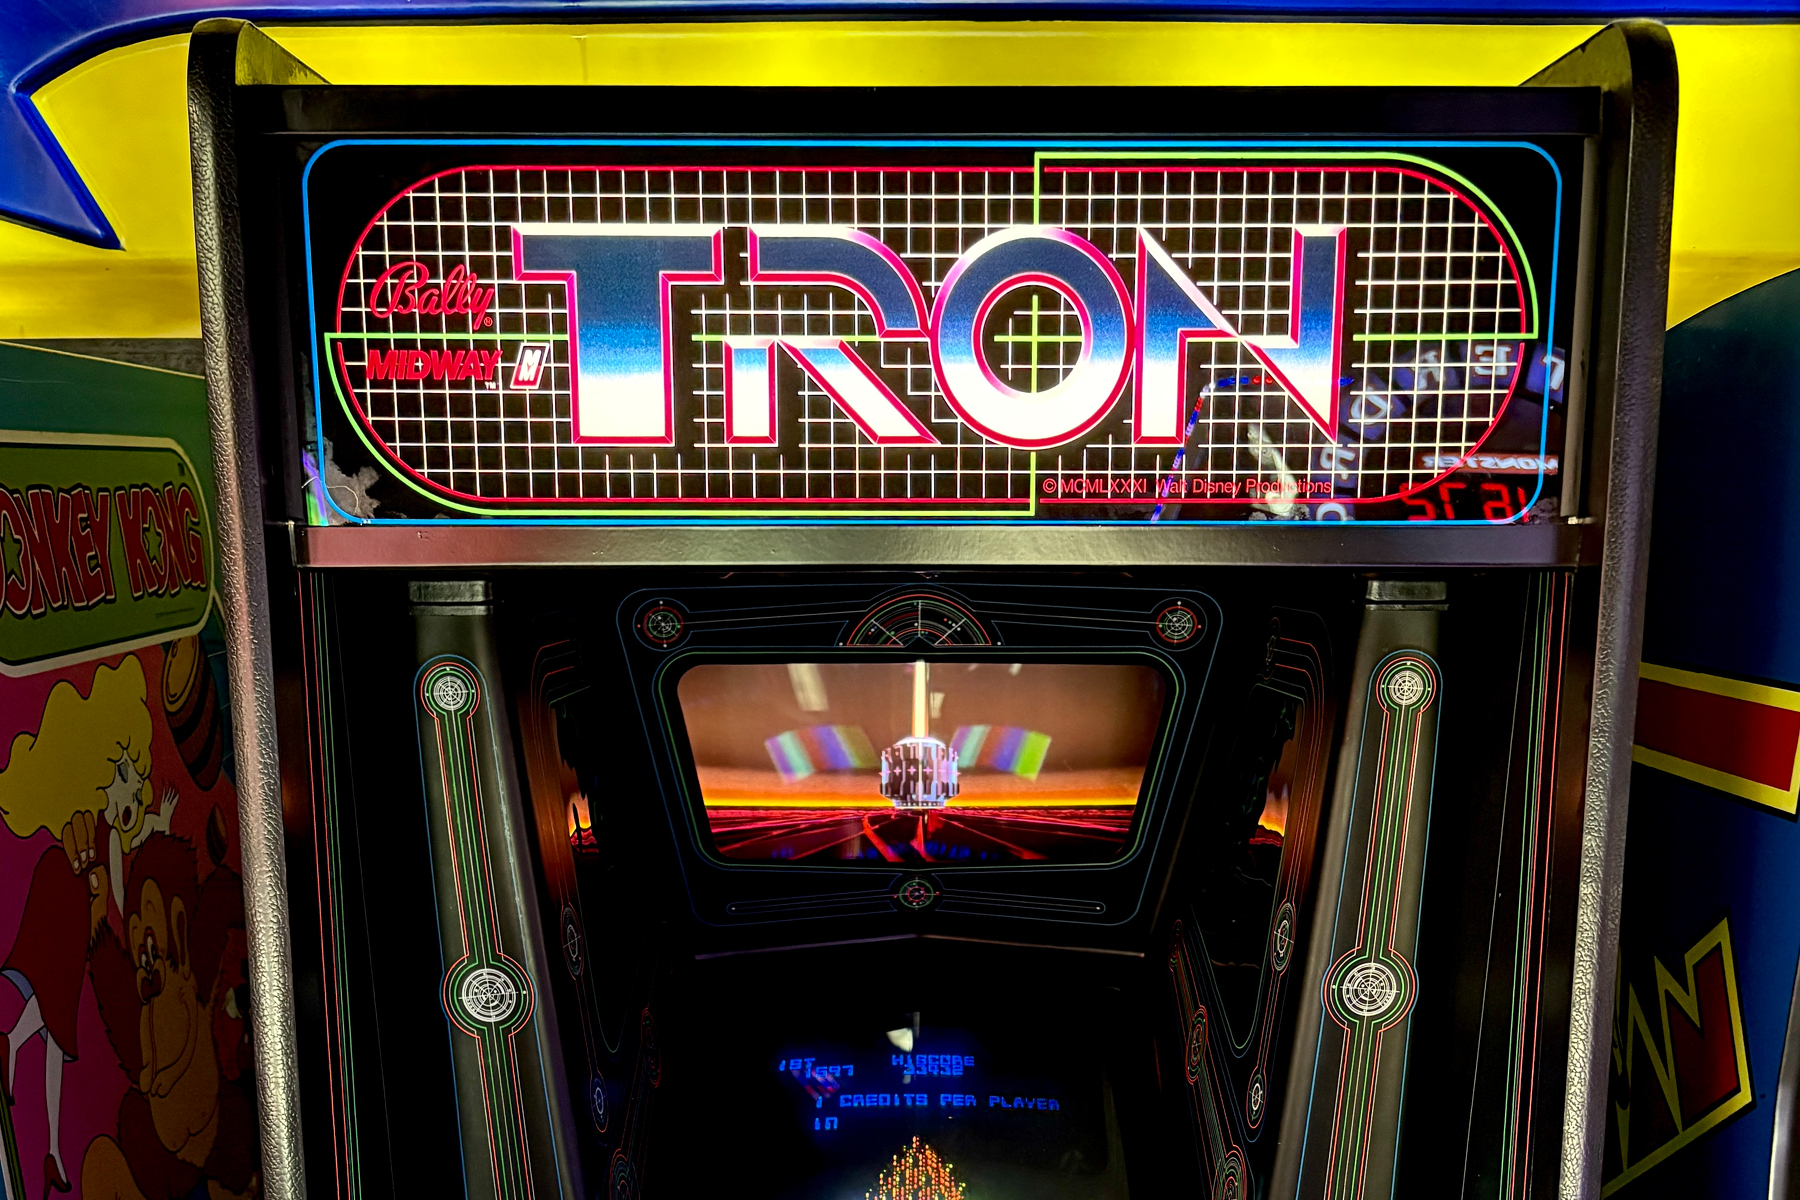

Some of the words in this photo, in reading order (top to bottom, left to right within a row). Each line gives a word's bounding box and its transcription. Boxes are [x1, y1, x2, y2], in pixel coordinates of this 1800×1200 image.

[369, 261, 495, 331] Bally
[511, 224, 1347, 449] TRON
[366, 350, 503, 380] MIDWAY
[1155, 478, 1188, 494] Walt
[1192, 478, 1242, 498] Disney
[1245, 479, 1333, 495] Productions
[116, 484, 207, 599] KONG
[805, 1064, 854, 1078] 1597
[839, 1093, 929, 1108] CREDITS
[939, 1093, 977, 1107] PER
[988, 1095, 1061, 1112] PLAYER
